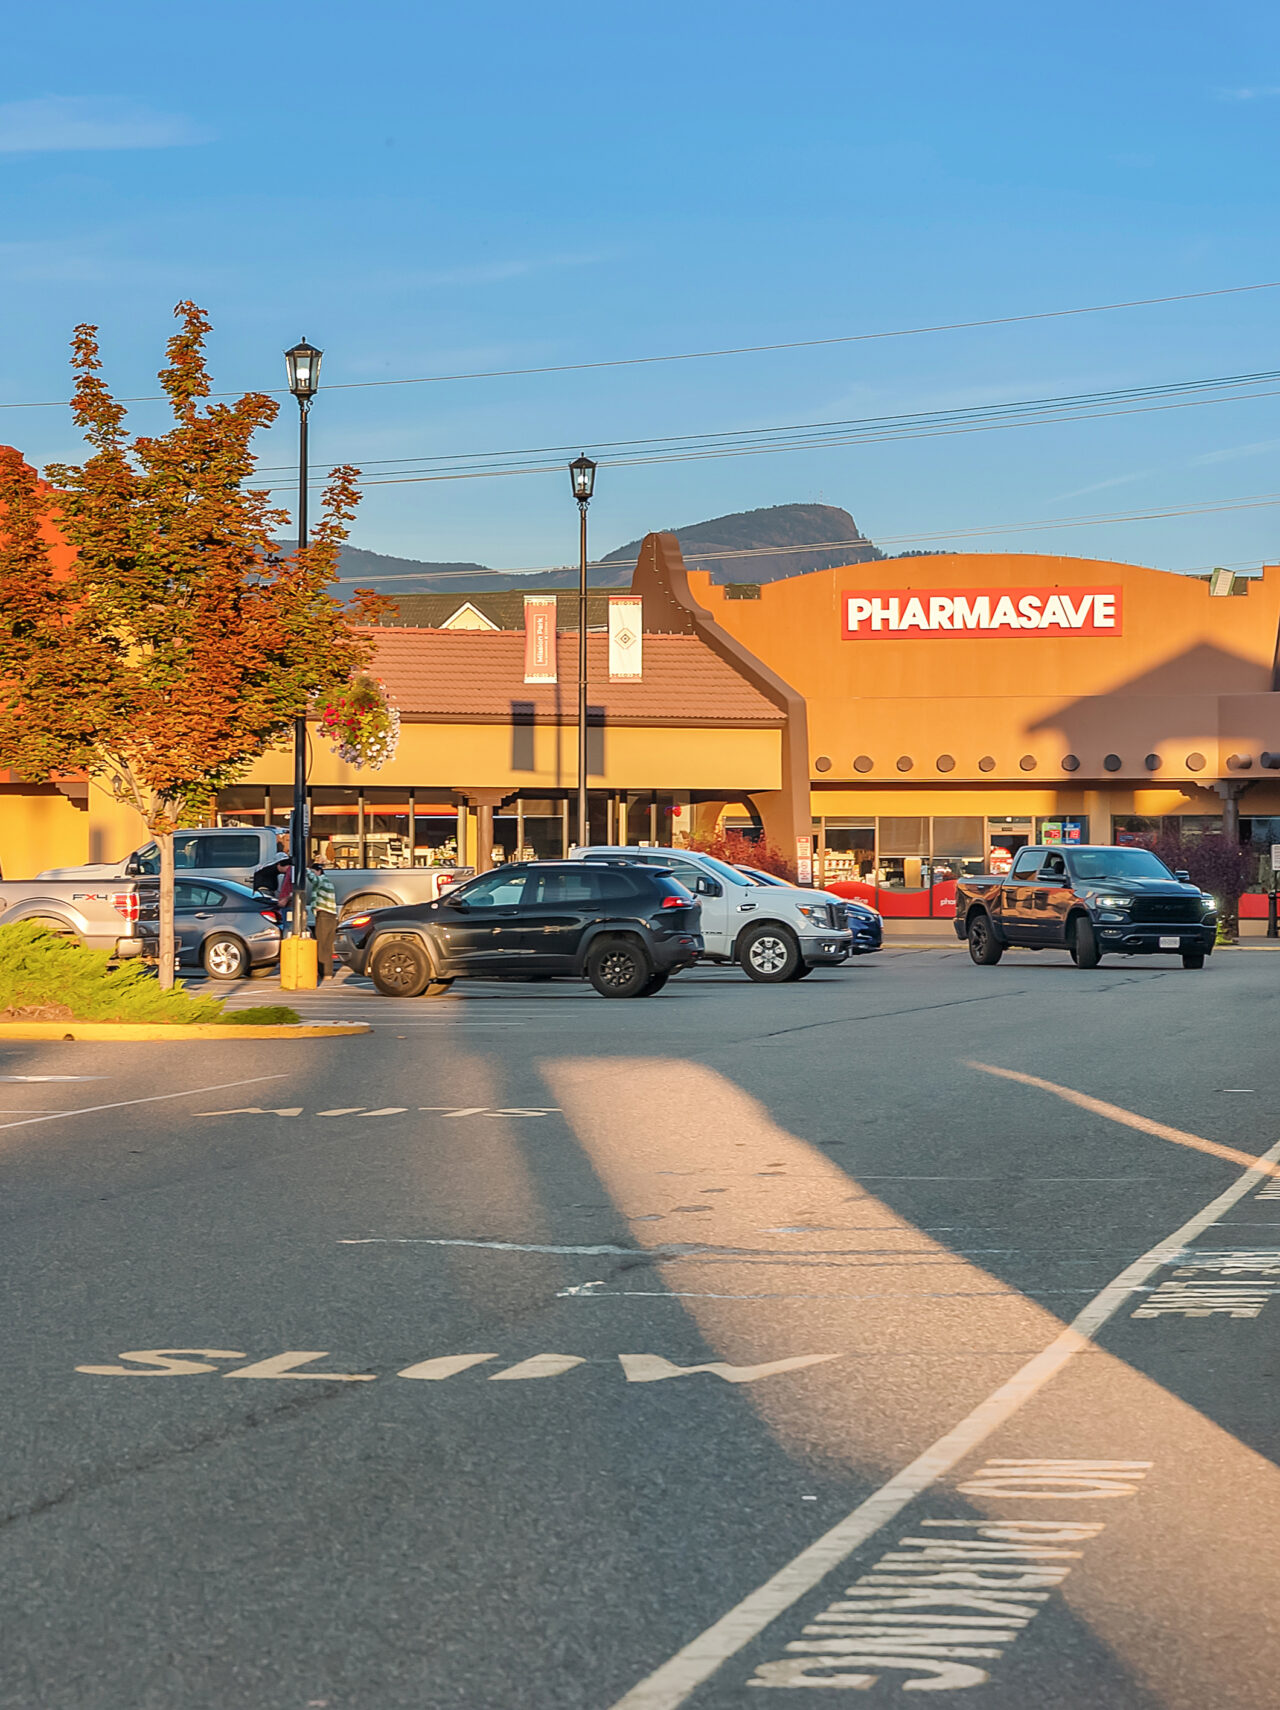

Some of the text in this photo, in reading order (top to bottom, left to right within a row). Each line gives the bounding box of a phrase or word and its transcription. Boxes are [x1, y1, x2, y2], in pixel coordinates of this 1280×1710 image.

[847, 594, 1116, 631] PHARMASAVE
[72, 893, 108, 901] FX4
[75, 1348, 842, 1383] SLOW
[956, 1458, 1154, 1500] NO
[746, 1519, 1106, 1692] PARKING
